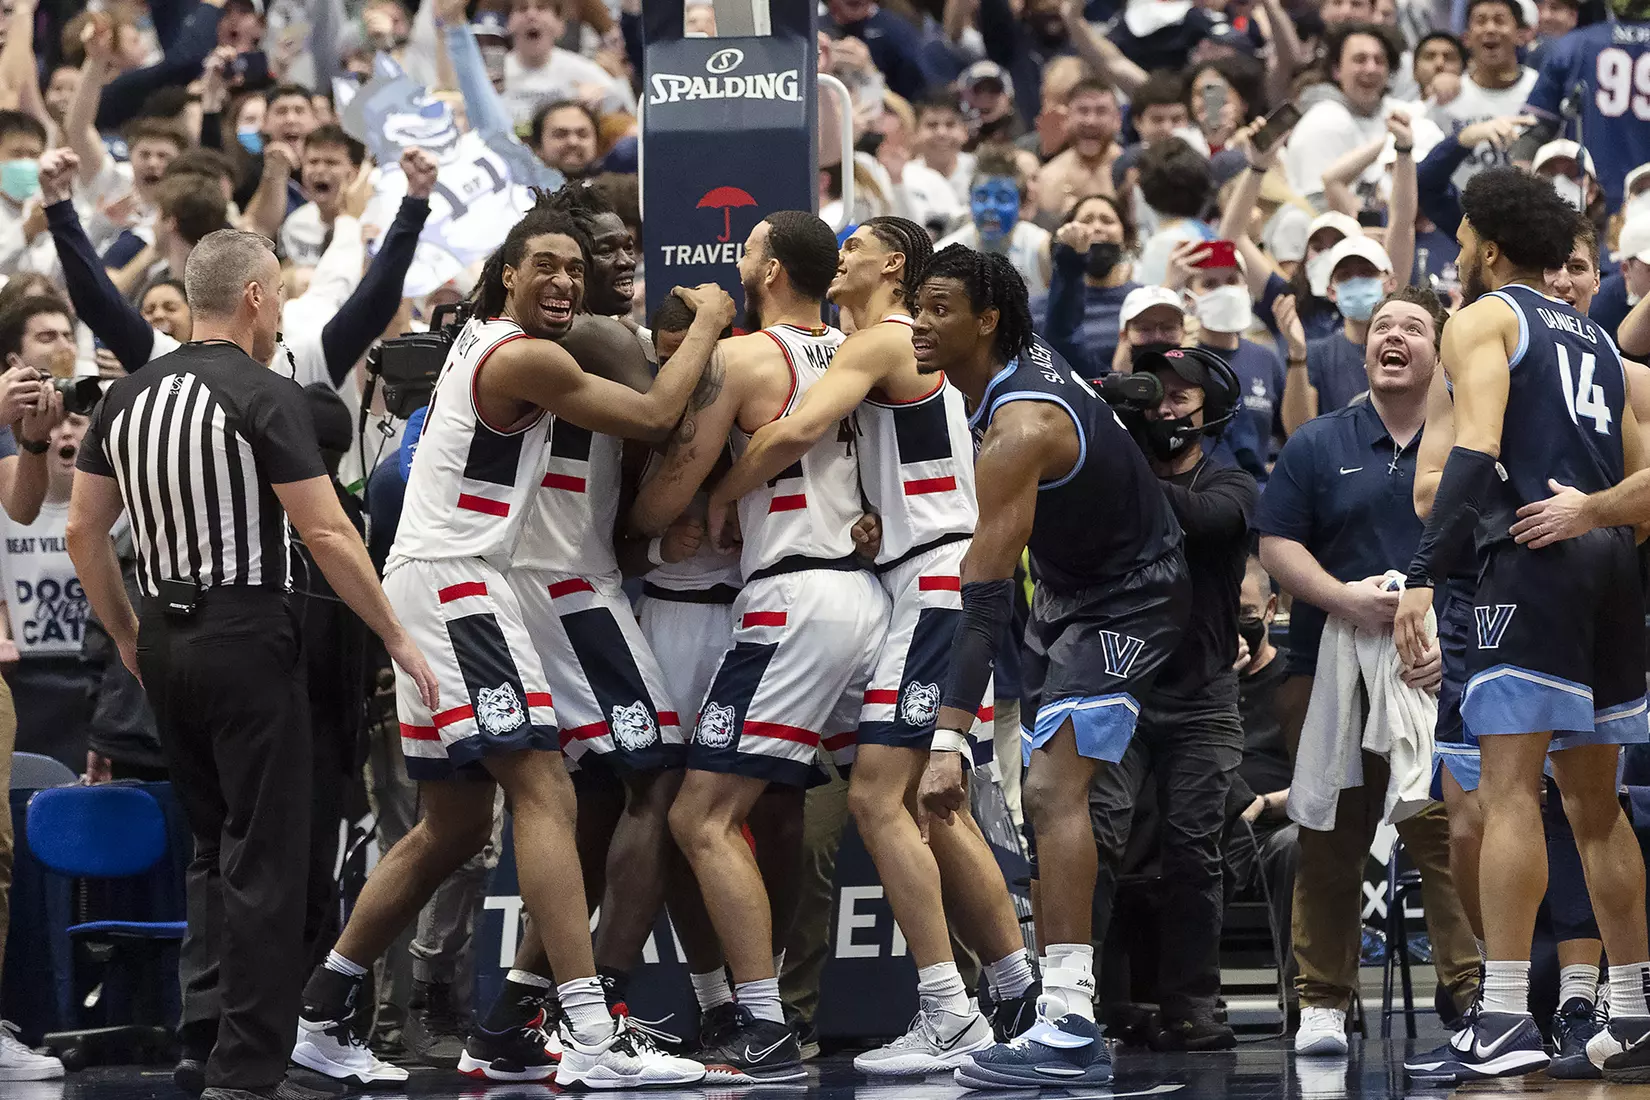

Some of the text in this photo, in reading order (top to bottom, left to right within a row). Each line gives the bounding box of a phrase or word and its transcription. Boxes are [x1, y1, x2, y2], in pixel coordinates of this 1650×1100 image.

[650, 69, 799, 105] SPALDING
[1536, 307, 1598, 344] DANIELS
[1554, 341, 1613, 436] 14
[1474, 604, 1517, 650] V
[1098, 630, 1146, 679] V
